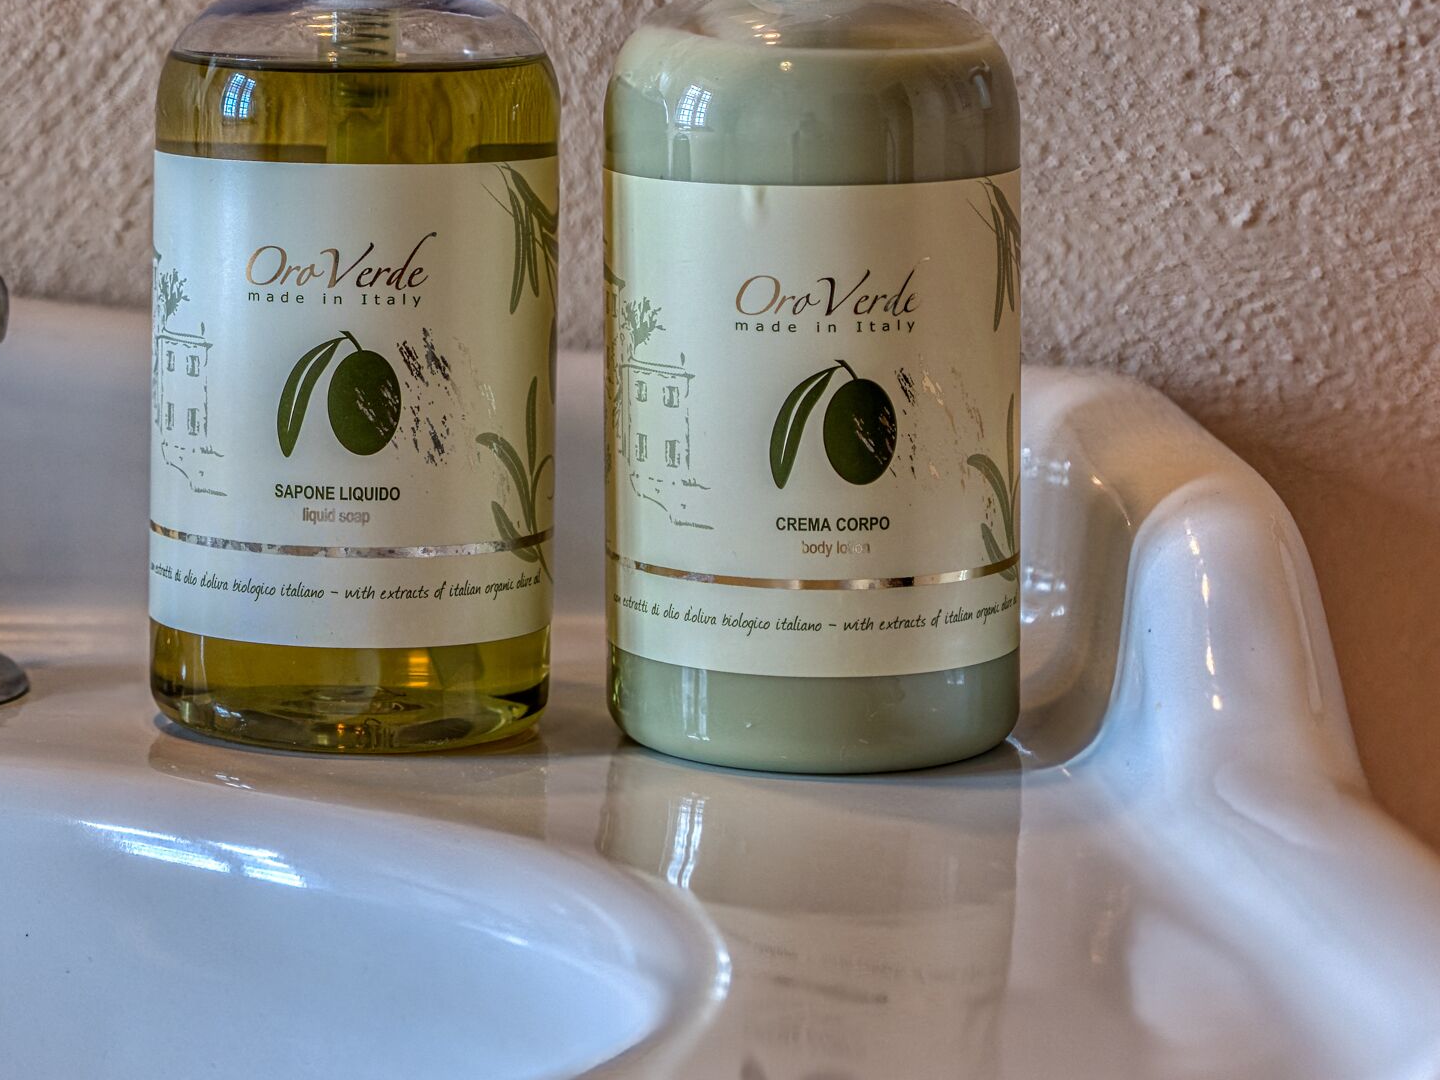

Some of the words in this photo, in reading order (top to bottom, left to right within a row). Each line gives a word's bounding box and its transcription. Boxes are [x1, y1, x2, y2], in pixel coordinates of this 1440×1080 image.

[248, 291, 305, 305] made
[323, 293, 343, 305] in
[361, 293, 422, 308] Italy
[735, 321, 797, 333] made
[816, 321, 837, 333] in
[856, 319, 915, 333] Italy
[274, 483, 336, 500] SAPONE
[339, 486, 401, 502] LIQUIDO
[302, 507, 336, 525] liquid
[338, 511, 371, 526] soap
[775, 516, 832, 532] CREMA
[836, 516, 890, 532] CORPO
[801, 540, 833, 558] body
[836, 540, 871, 554] loion
[174, 569, 182, 582] di
[183, 569, 198, 586] olio
[200, 571, 229, 591] d'oliva
[232, 578, 277, 602] biologico
[280, 581, 325, 599] italiano
[344, 585, 375, 600] with
[379, 585, 429, 600] extracts
[433, 581, 447, 600] of
[449, 579, 481, 597] italian
[484, 578, 514, 600] organic
[622, 595, 649, 613] estratti
[651, 603, 660, 616] di
[663, 604, 680, 620] olio
[684, 606, 717, 625] d'oliva
[722, 612, 771, 637] biologico
[775, 615, 822, 632] italiano
[843, 617, 874, 631] with
[879, 615, 926, 631] extracts
[931, 609, 942, 628] of
[944, 607, 973, 624] italian
